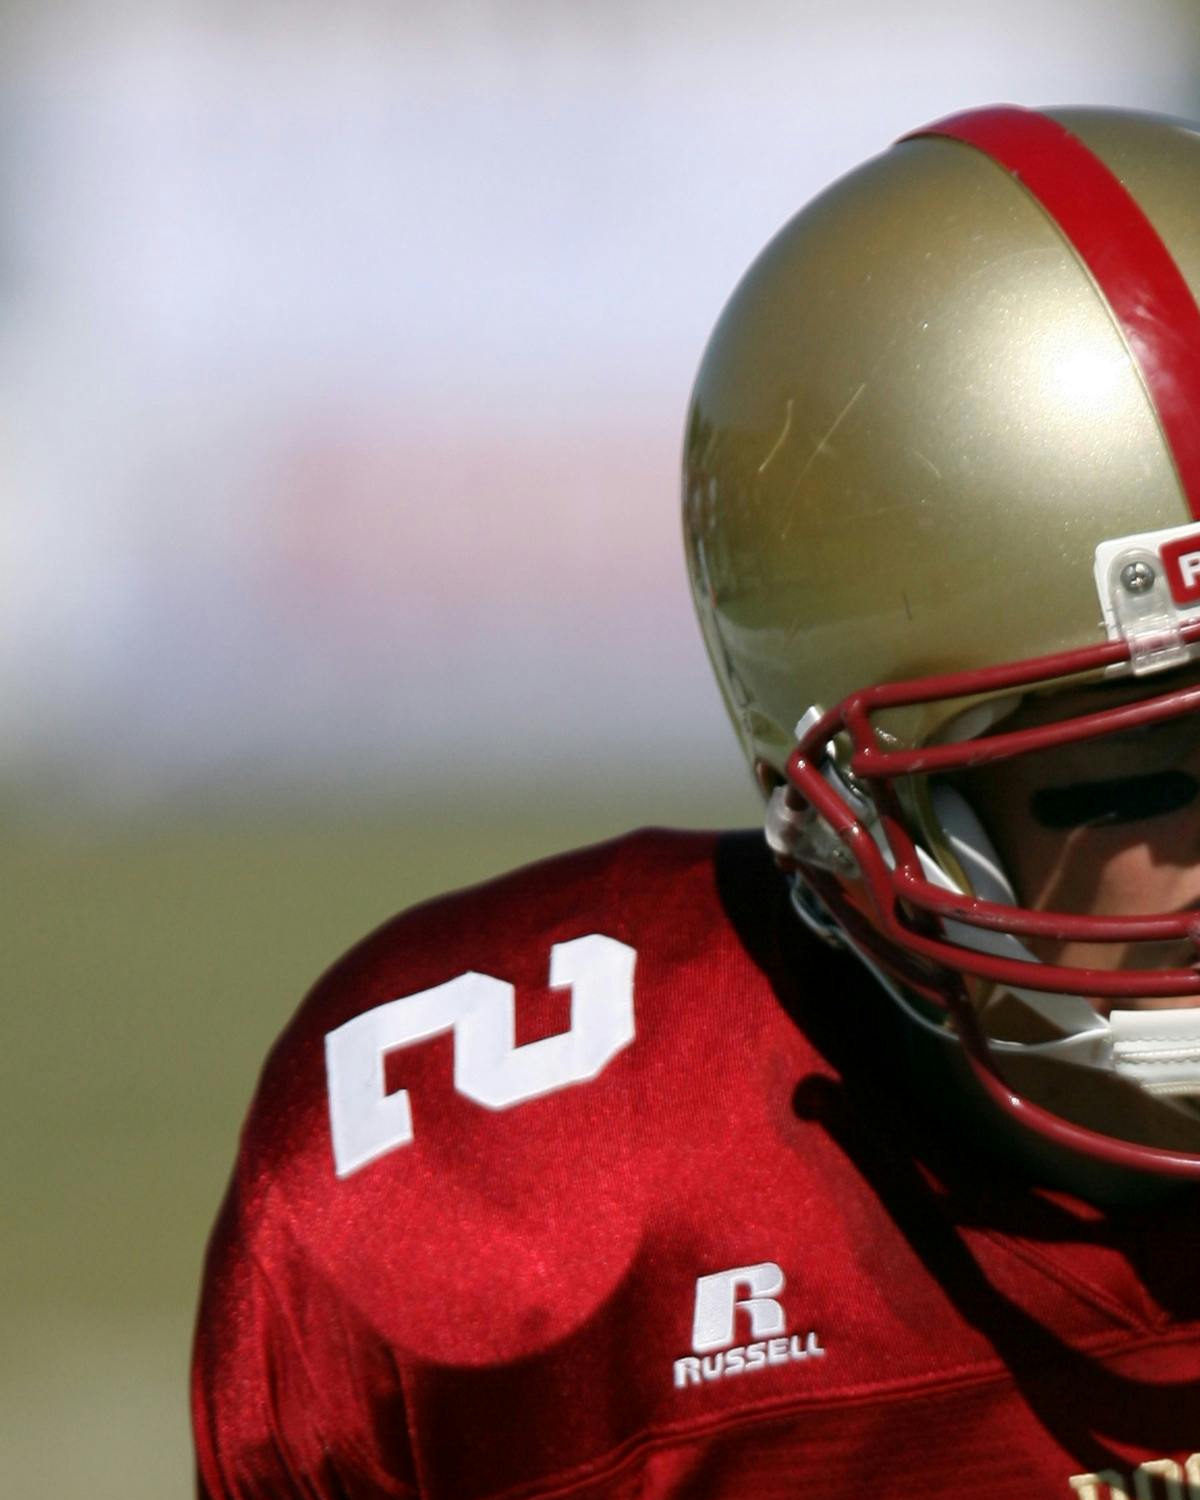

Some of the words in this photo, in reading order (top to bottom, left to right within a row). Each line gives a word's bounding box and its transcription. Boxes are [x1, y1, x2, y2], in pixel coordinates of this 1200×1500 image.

[324, 933, 637, 1180] 2
[692, 1261, 787, 1354] R
[673, 1332, 825, 1389] RUSSELL
